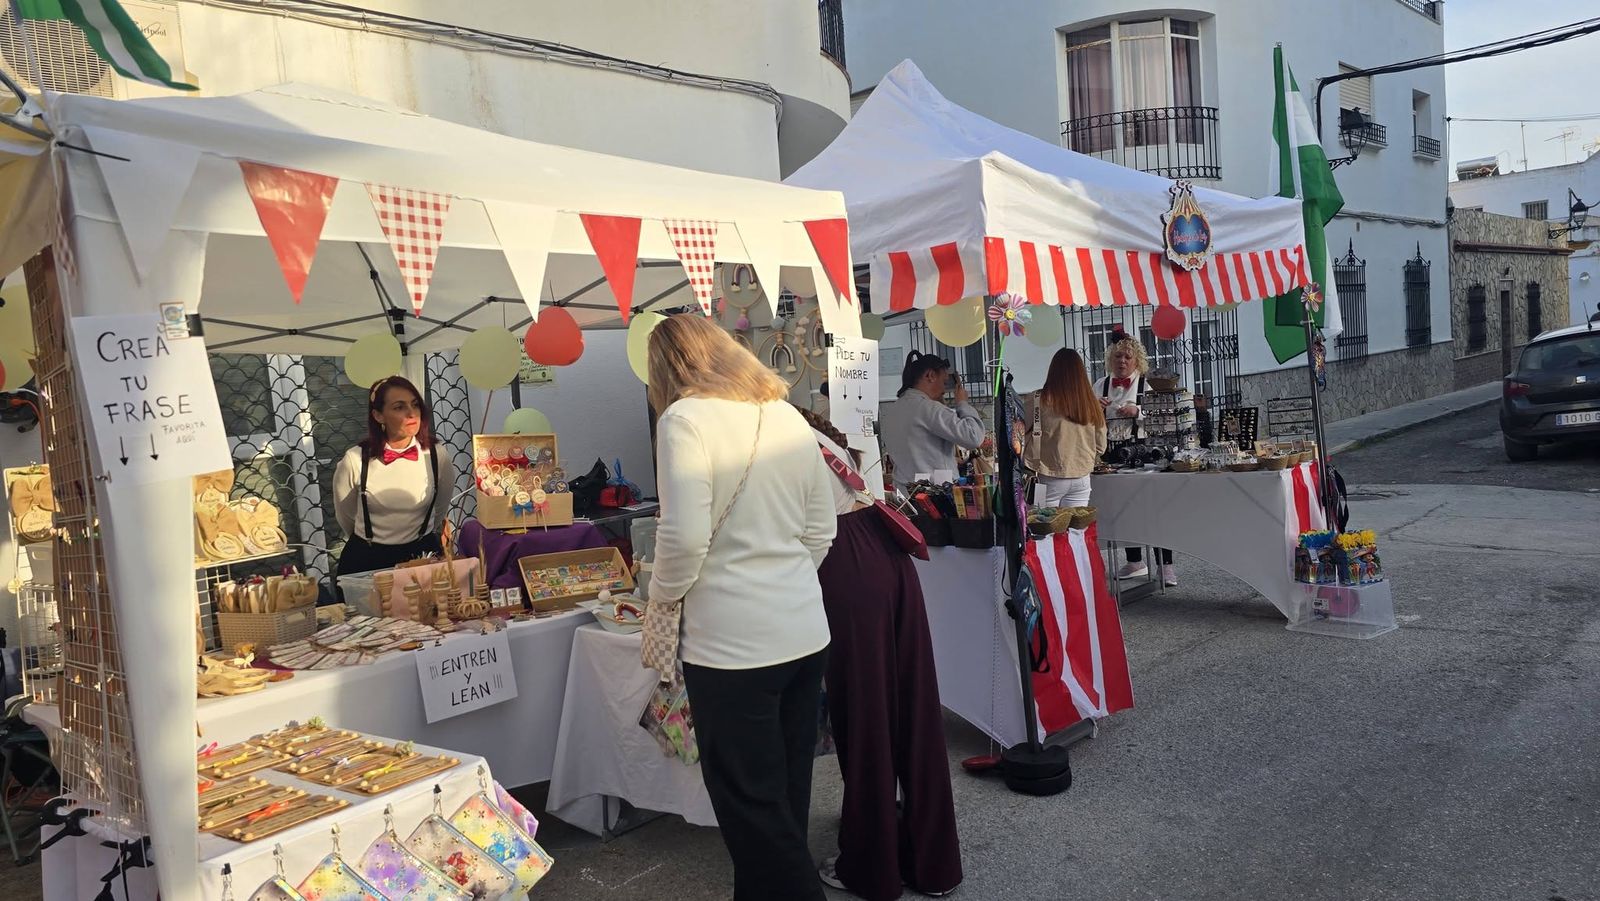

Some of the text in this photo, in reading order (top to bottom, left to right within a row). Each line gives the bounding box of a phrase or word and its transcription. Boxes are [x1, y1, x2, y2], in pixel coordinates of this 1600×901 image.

[97, 331, 170, 363] CREA
[836, 345, 871, 361] PIDE TU
[835, 366, 868, 380] NOMBRE
[120, 375, 148, 393] TU
[103, 394, 193, 424] FRASE
[1565, 414, 1591, 423] 1010
[161, 421, 206, 435] FAVORITA
[464, 672, 472, 685] Y
